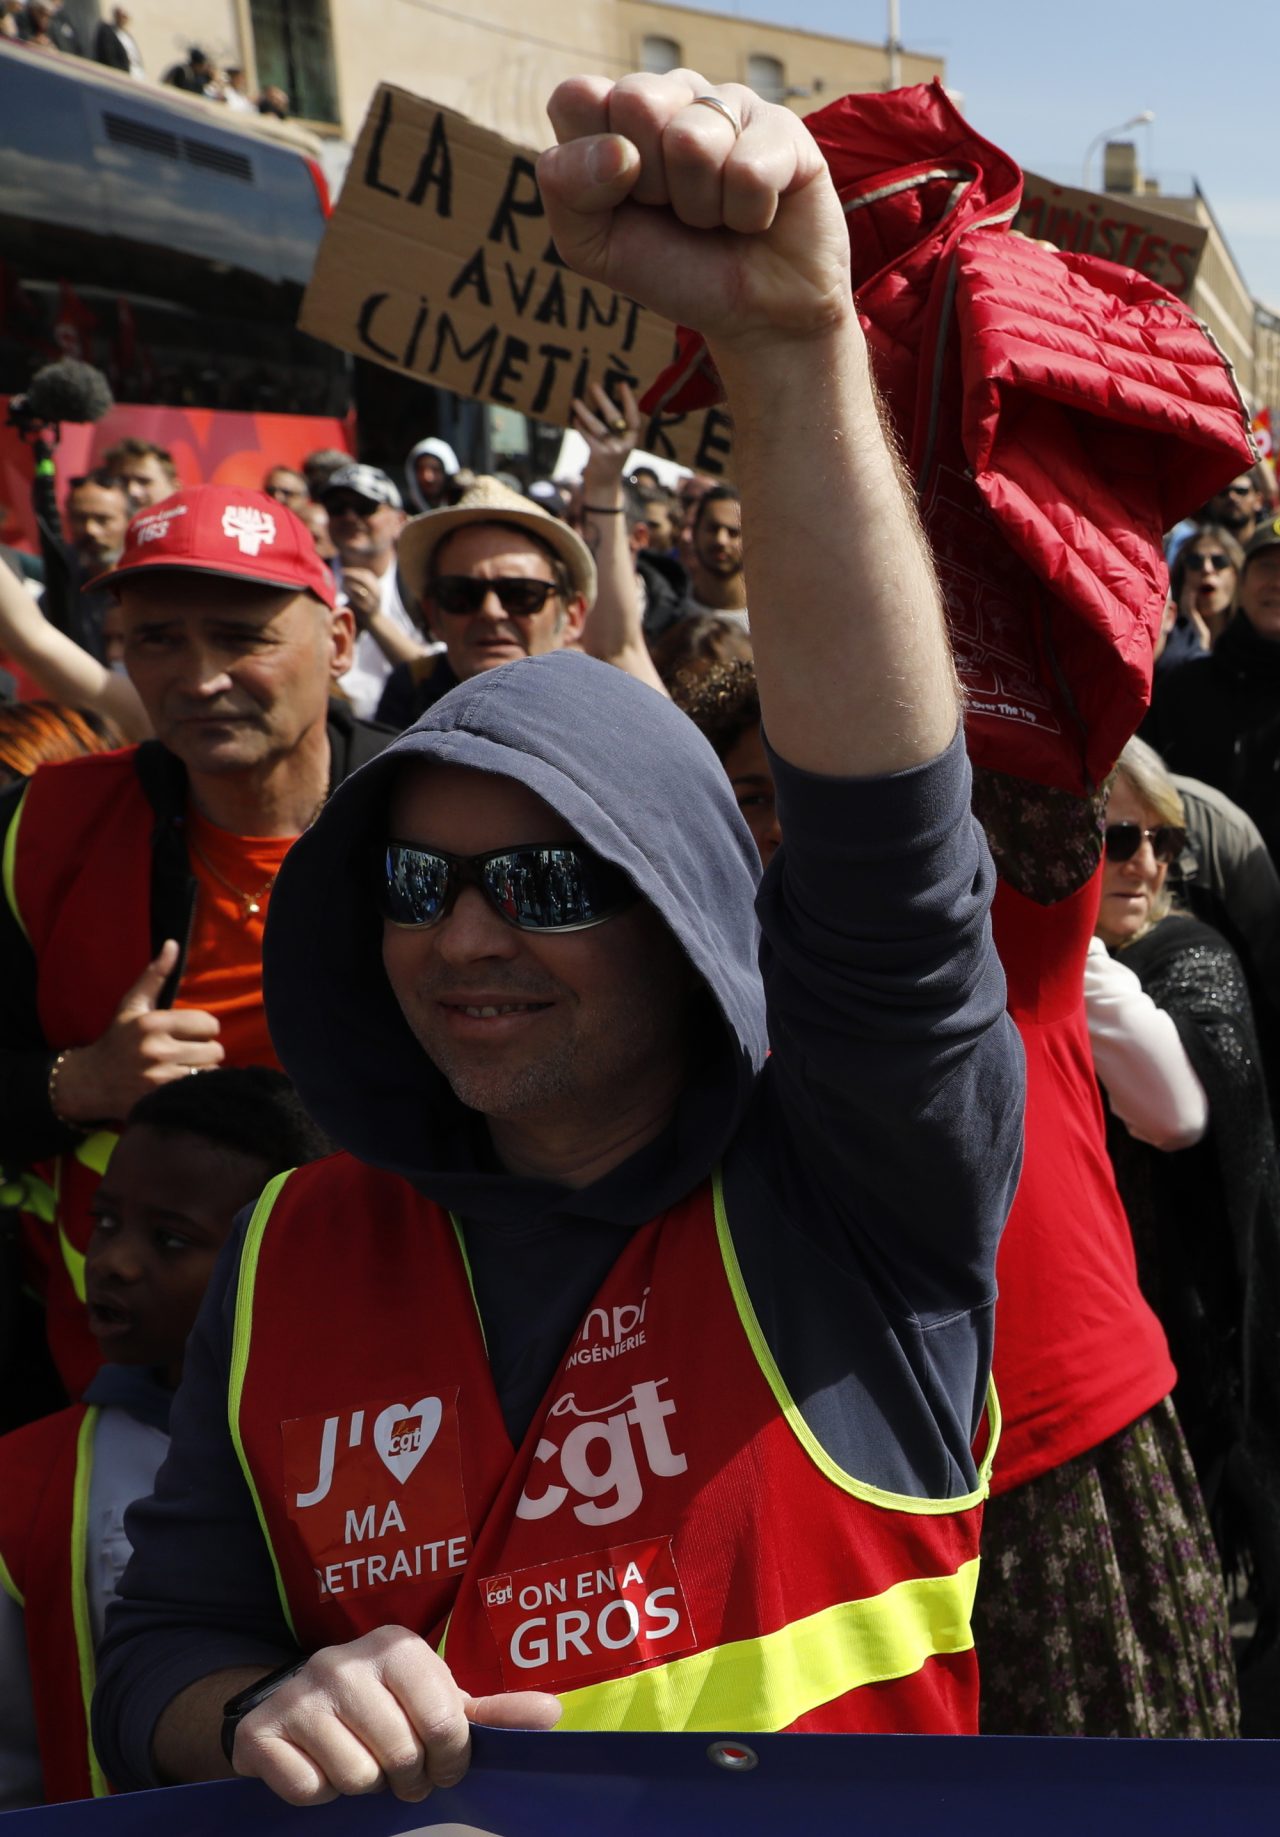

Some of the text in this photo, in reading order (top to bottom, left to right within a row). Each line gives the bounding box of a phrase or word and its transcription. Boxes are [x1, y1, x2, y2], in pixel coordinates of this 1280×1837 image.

[364, 91, 454, 218] LA
[448, 246, 647, 352] AVANT
[998, 702, 1019, 715] The
[296, 1410, 365, 1508] J'
[389, 1427, 423, 1453] cgt
[516, 1380, 688, 1526] cgt
[344, 1500, 406, 1545] MA
[487, 1584, 513, 1605] cgt
[518, 1561, 644, 1610] ON EN A
[510, 1586, 680, 1669] GROS
